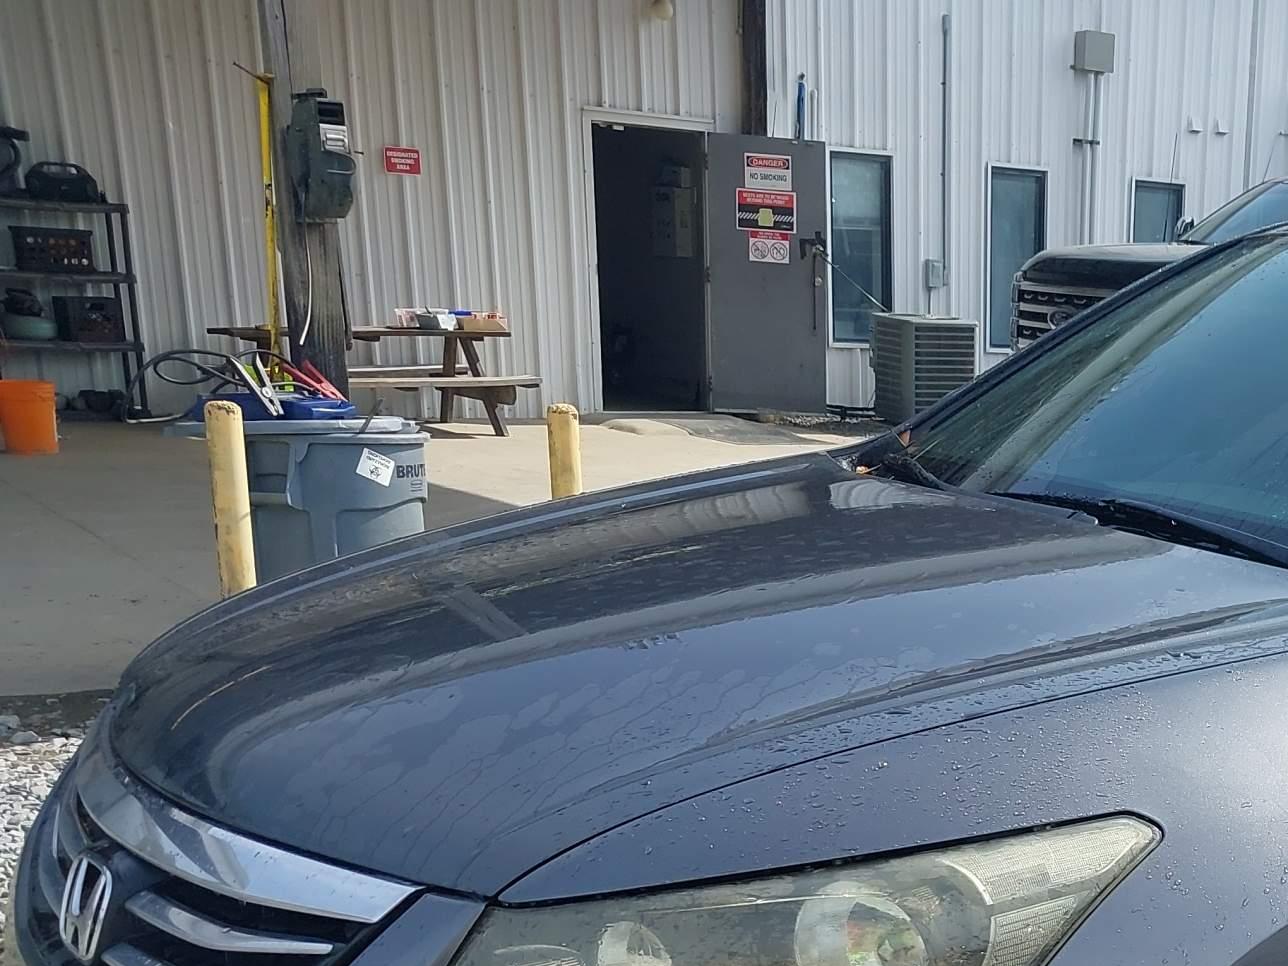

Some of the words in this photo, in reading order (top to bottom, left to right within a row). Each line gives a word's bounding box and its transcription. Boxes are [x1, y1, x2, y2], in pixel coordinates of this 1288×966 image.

[752, 158, 784, 167] DANGER
[750, 172, 758, 180] NO
[760, 172, 787, 182] SMOKING
